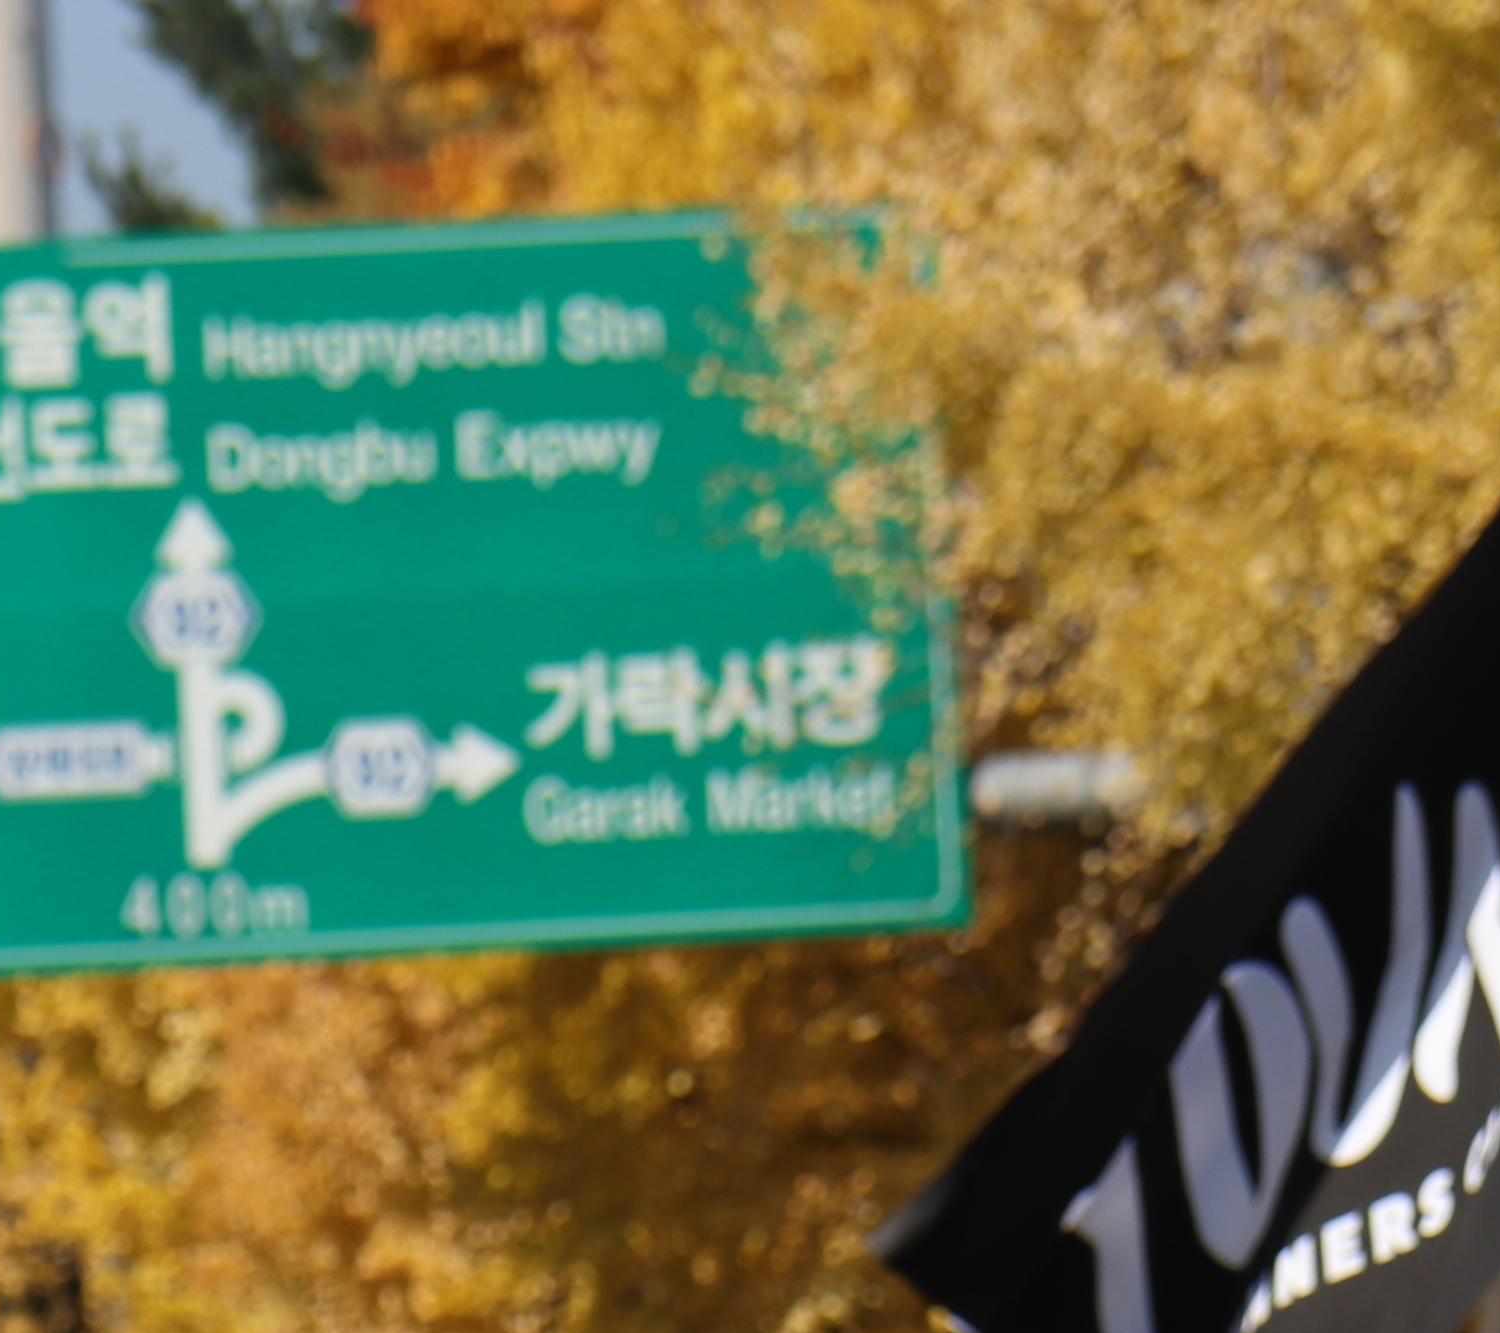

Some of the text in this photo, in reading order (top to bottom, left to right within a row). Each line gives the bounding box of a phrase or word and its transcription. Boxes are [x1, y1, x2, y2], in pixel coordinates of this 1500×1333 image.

[201, 291, 668, 390] Hangnyeoul Stn
[205, 408, 662, 504] Dongbu Expwy
[523, 635, 895, 762] 가락시장
[523, 763, 896, 846] Garak Market
[118, 872, 311, 940] 400m
